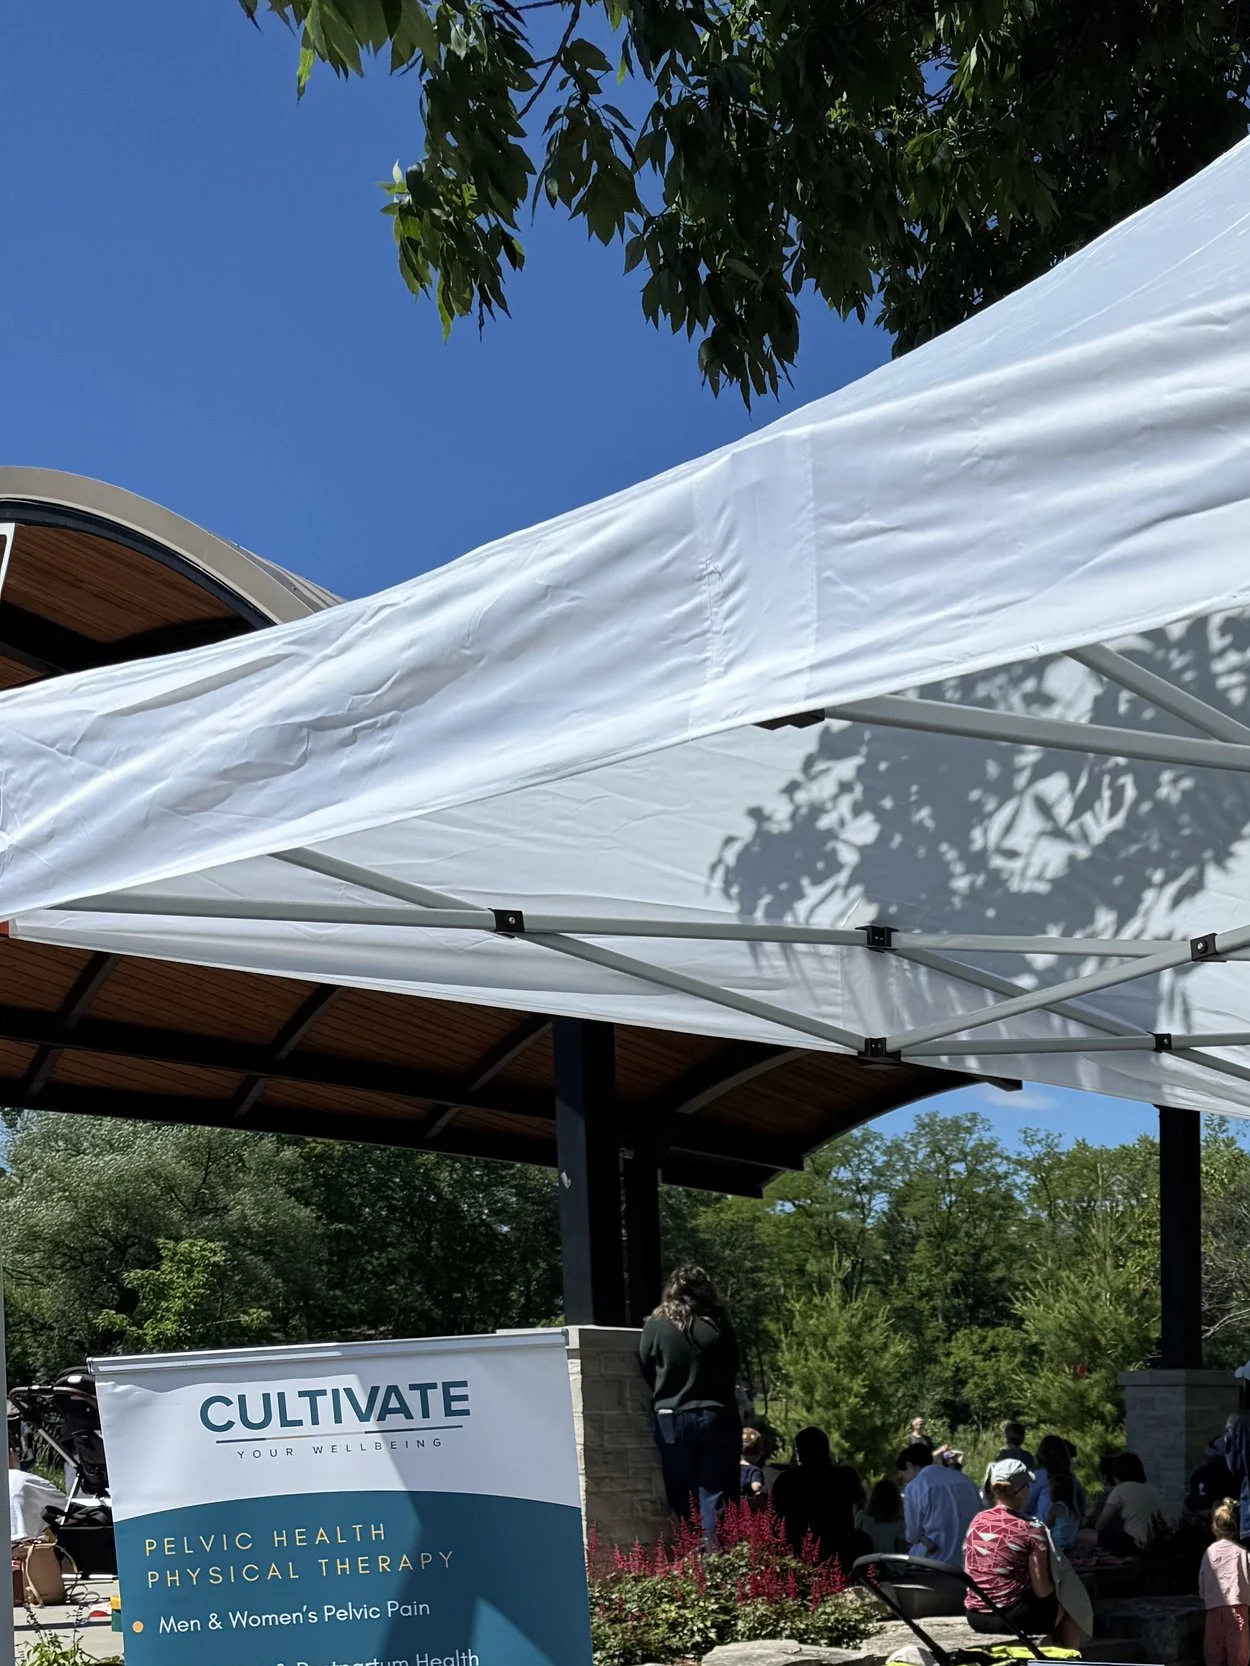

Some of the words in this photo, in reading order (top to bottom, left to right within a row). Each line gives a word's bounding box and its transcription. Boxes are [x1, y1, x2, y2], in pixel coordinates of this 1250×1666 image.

[199, 1380, 471, 1433] CULTIVATE
[237, 1446, 294, 1460] YOUR
[312, 1438, 443, 1455] WELLBEING
[145, 1532, 254, 1557] PELVIC
[273, 1524, 385, 1547] HEALTH
[147, 1561, 300, 1589] PHYSICAL
[319, 1551, 454, 1577] THERAPY
[158, 1615, 200, 1635] Men
[208, 1614, 222, 1630] &
[324, 1602, 382, 1623] Pelvic
[387, 1600, 431, 1617] Pain
